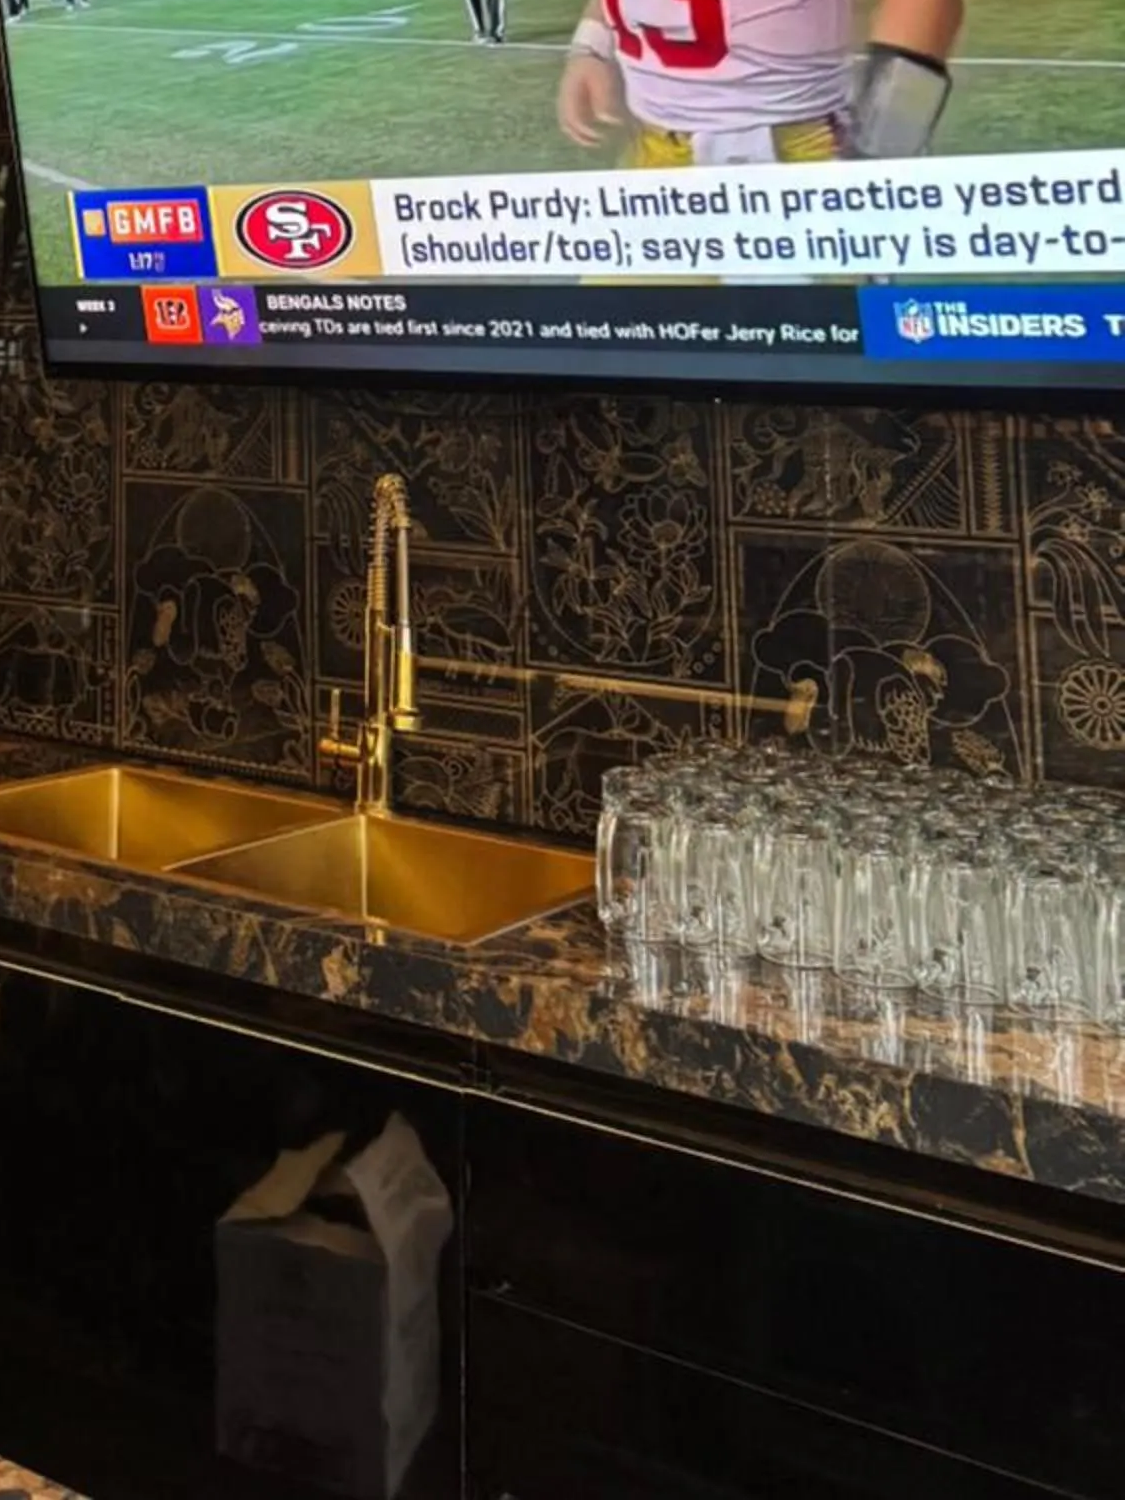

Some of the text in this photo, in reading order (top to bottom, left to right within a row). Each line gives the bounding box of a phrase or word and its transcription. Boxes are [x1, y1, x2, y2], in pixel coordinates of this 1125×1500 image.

[394, 168, 1122, 224] Brock Purdy: Limited in practice yesterd
[113, 205, 197, 235] GMFB
[401, 223, 1125, 267] (shoulder/toe); says toe injury is day-to-
[266, 294, 407, 312] BENGALS NOTES
[934, 301, 967, 313] THE
[313, 318, 344, 335] TDs
[347, 322, 371, 335] are
[374, 319, 404, 336] tied
[407, 319, 437, 336] first
[442, 320, 486, 337] since
[489, 320, 534, 338] 2021
[540, 321, 573, 338] and
[575, 321, 611, 338] tied
[615, 322, 654, 339] with
[659, 322, 720, 341] HOFer
[726, 323, 775, 346] Jerry
[780, 324, 825, 342] Rice
[830, 324, 860, 342] for
[937, 314, 1087, 337] INSIDERS
